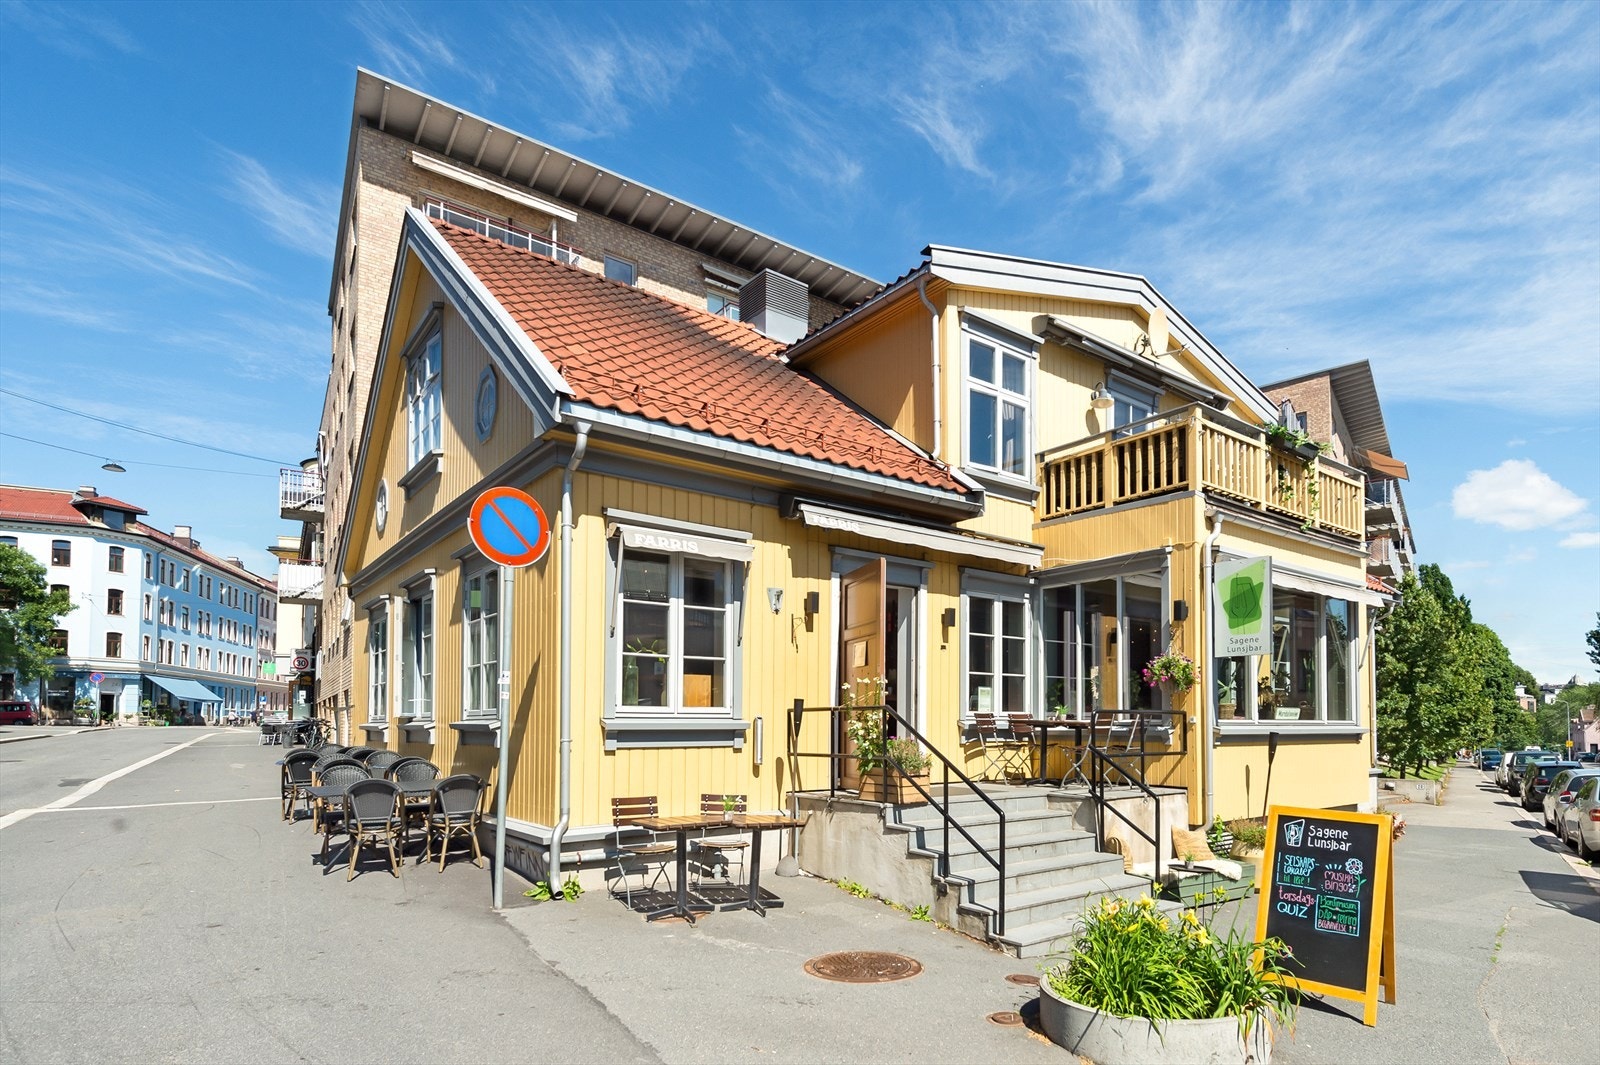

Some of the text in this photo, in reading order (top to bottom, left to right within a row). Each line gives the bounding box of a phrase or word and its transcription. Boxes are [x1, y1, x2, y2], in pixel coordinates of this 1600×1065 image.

[634, 534, 699, 553] FARRIS
[1229, 636, 1260, 646] Sagene
[1227, 645, 1263, 654] Lunsjbar
[1308, 825, 1348, 839] Sagene
[1308, 837, 1352, 851] Lunsjbar
